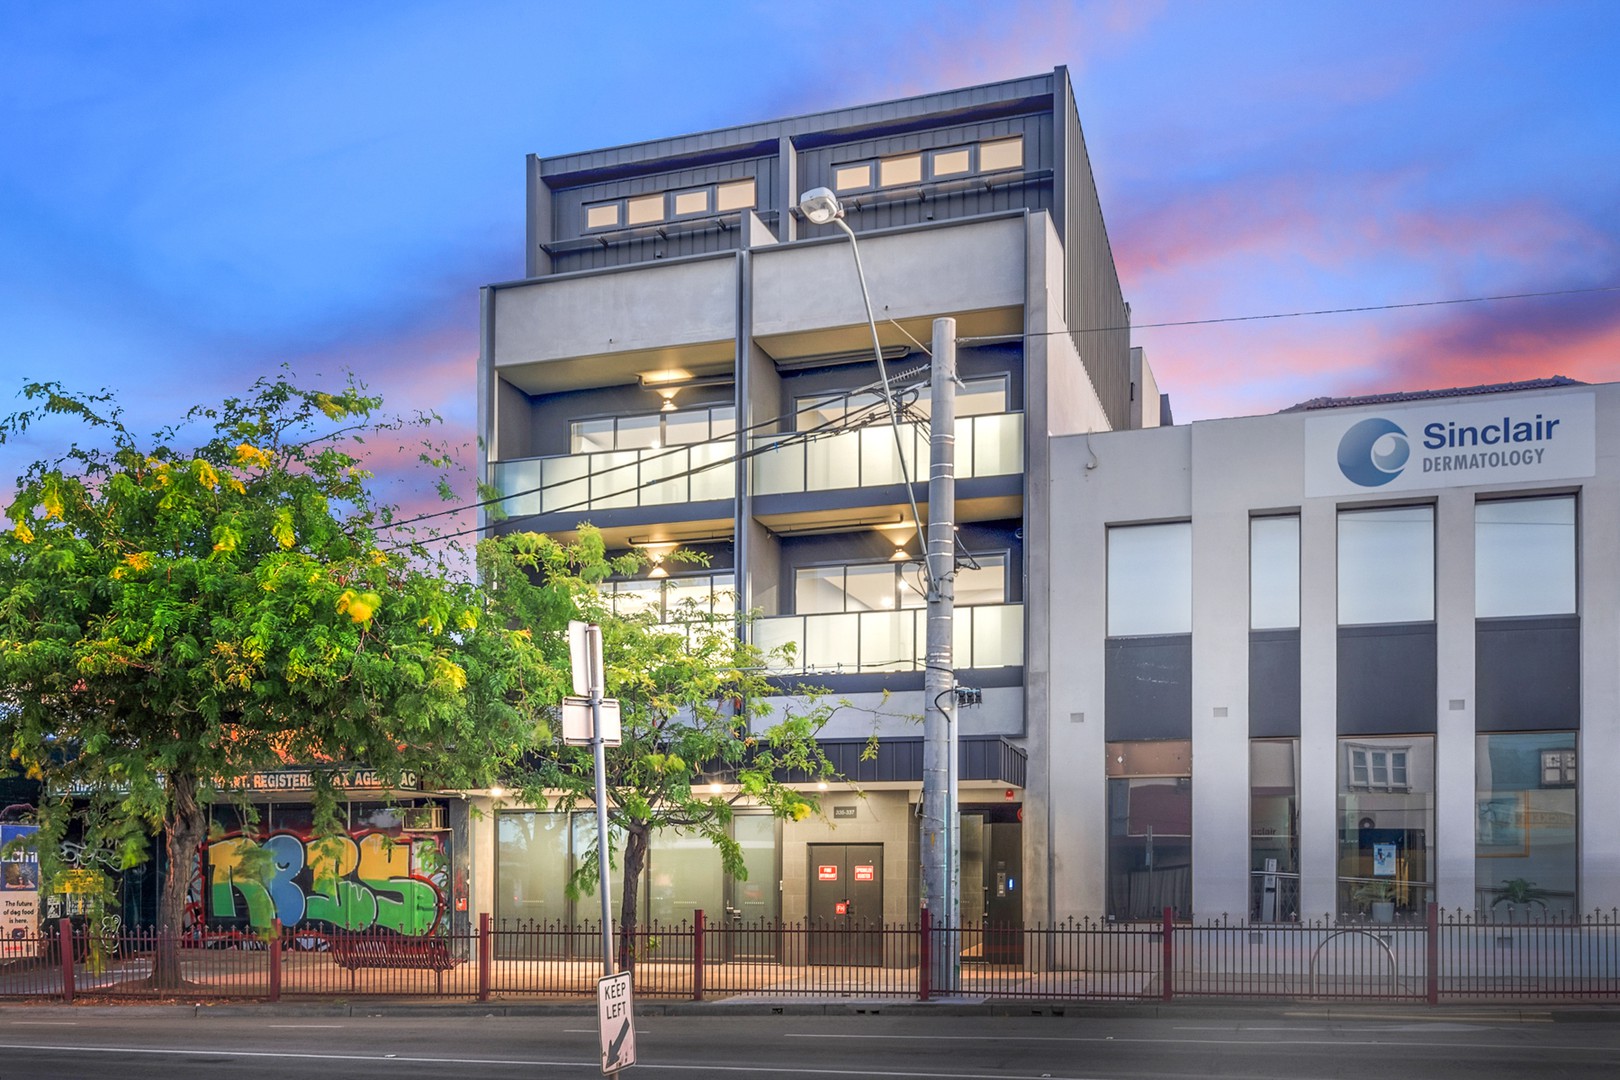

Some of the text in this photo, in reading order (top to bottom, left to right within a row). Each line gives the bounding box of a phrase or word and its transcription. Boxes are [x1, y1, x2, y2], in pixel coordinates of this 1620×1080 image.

[1423, 414, 1560, 449] Sinclair
[1423, 448, 1545, 473] DERMATOLOGY
[254, 773, 315, 788] REGISTERE
[327, 772, 350, 787] AX
[355, 771, 392, 787] AGE
[605, 982, 626, 1000] KEEP
[606, 1001, 626, 1020] LEFT
